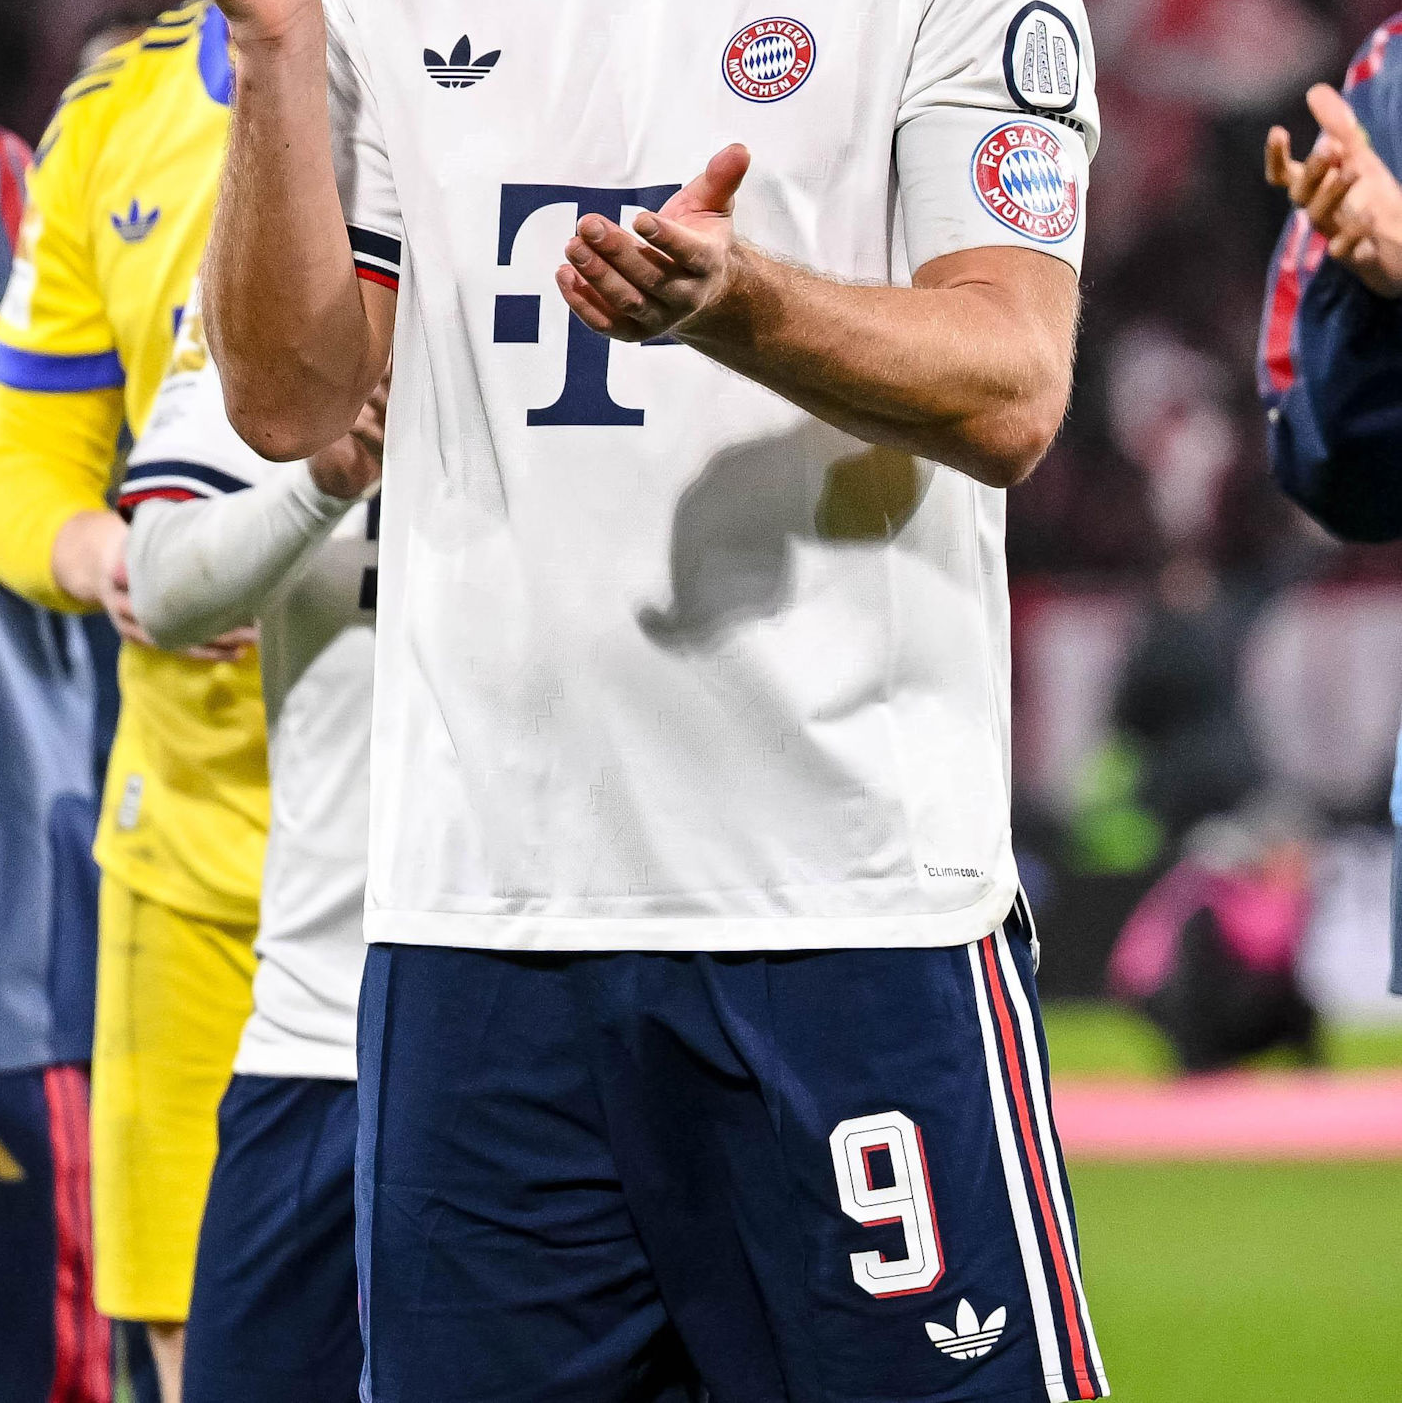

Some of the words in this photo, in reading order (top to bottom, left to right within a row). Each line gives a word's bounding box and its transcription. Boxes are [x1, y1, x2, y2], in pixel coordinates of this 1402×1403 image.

[735, 33, 753, 50] FC
[755, 22, 808, 50] BAYERN
[981, 141, 1005, 168] FC
[828, 1110, 946, 1299] 9
